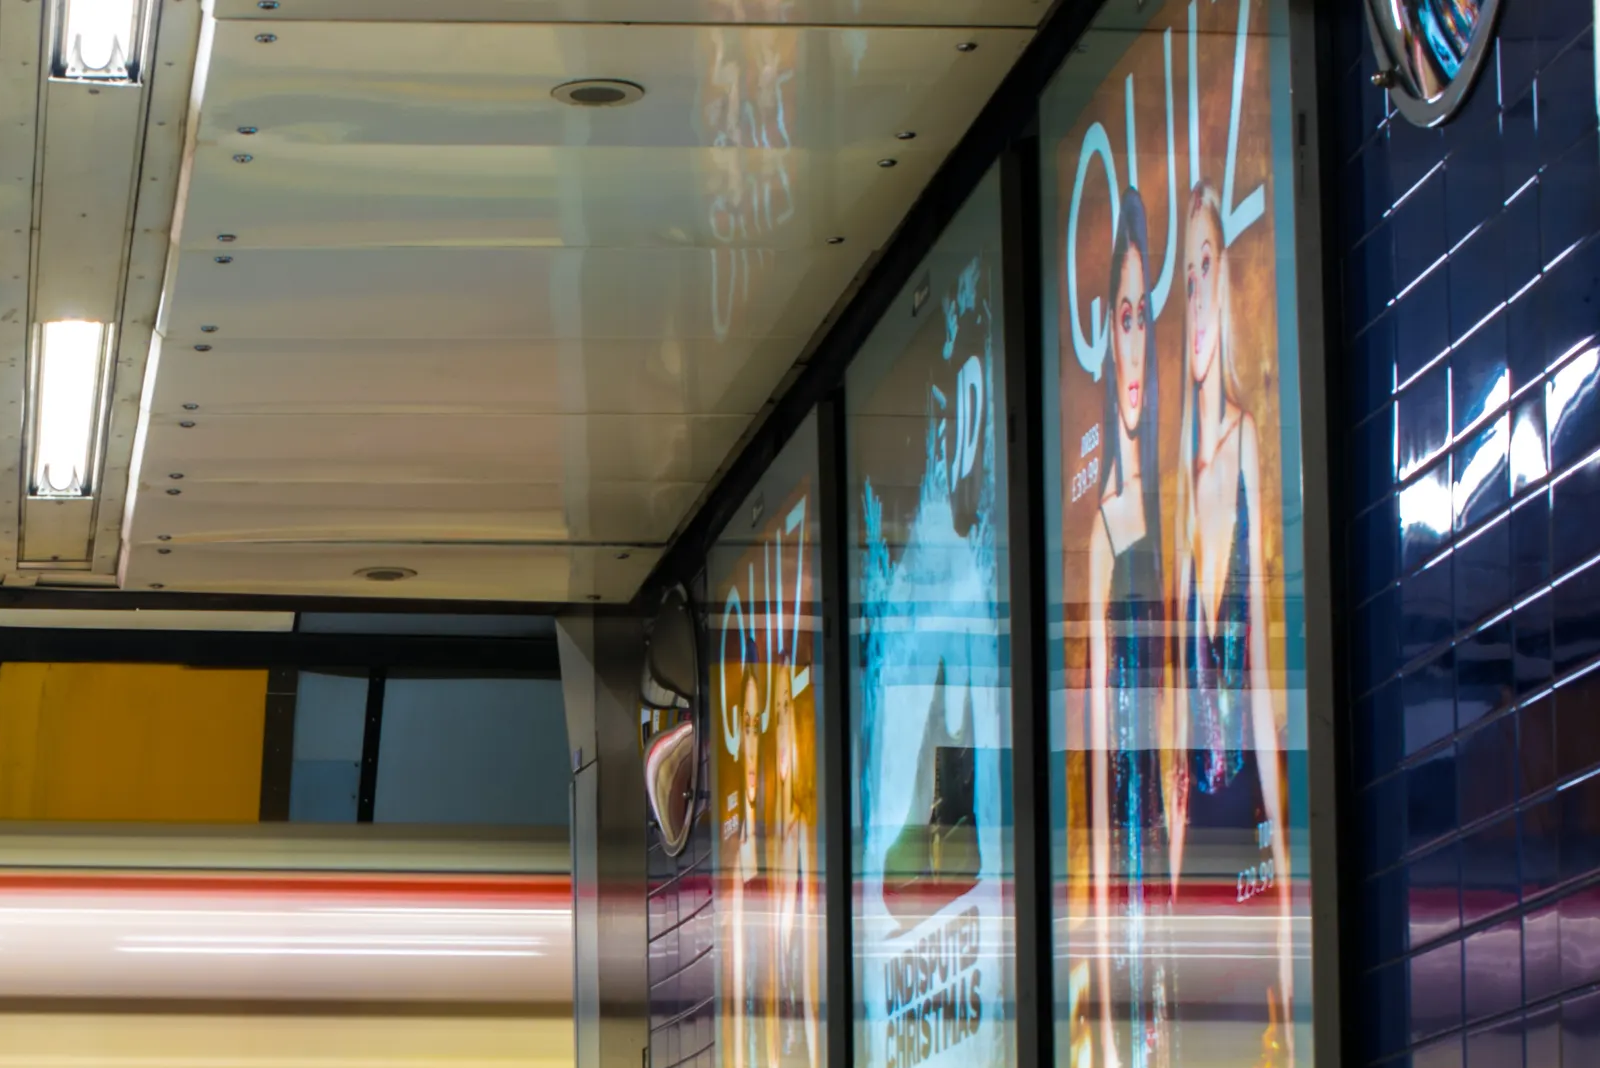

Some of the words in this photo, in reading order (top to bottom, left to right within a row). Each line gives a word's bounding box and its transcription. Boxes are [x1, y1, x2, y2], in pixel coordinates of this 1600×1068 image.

[1067, 0, 1265, 382] QUIZ
[720, 495, 810, 762] QUIZ
[884, 905, 980, 1016] UNDISPUTED
